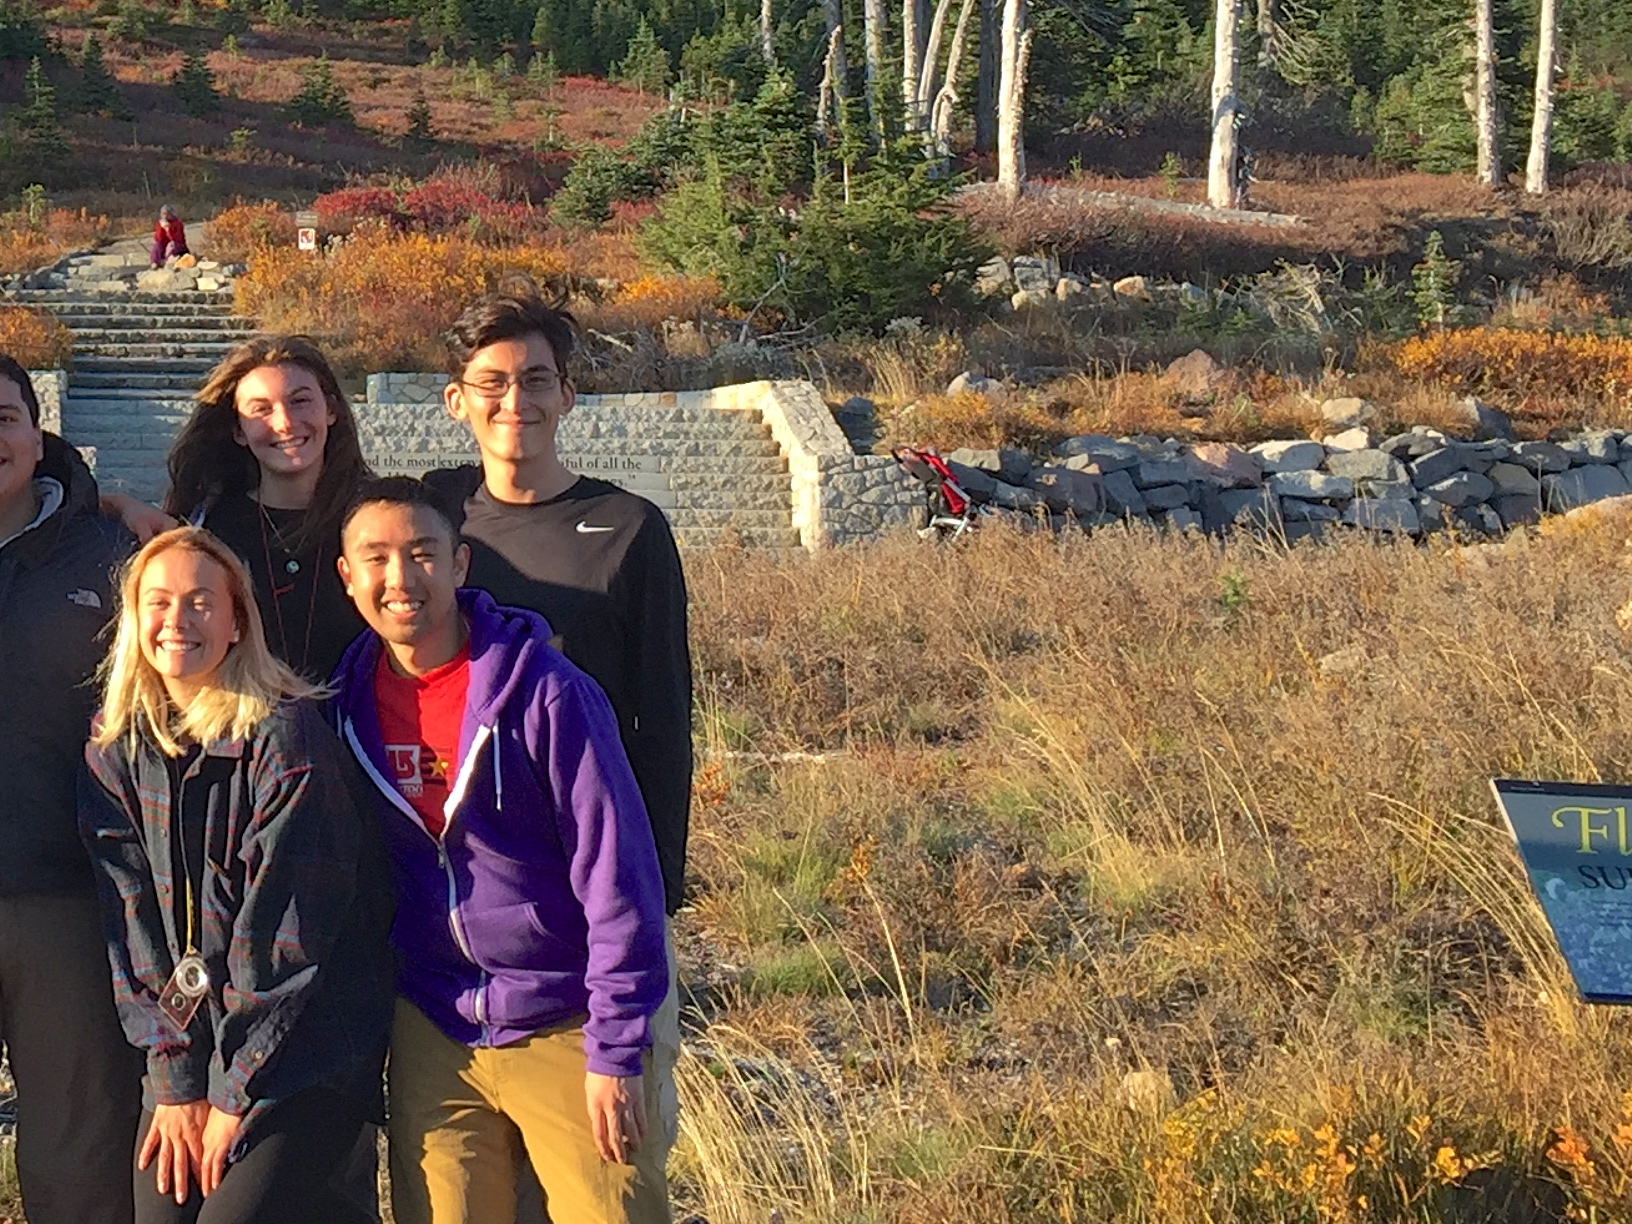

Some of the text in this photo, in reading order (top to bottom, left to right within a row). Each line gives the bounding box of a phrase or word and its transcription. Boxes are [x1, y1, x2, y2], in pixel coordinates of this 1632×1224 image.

[364, 455, 379, 466] nd
[383, 455, 403, 467] the
[407, 456, 436, 467] most
[586, 457, 600, 469] of
[602, 457, 618, 469] all
[622, 457, 642, 469] the
[1551, 805, 1632, 857] Fl
[1577, 864, 1632, 890] SU
